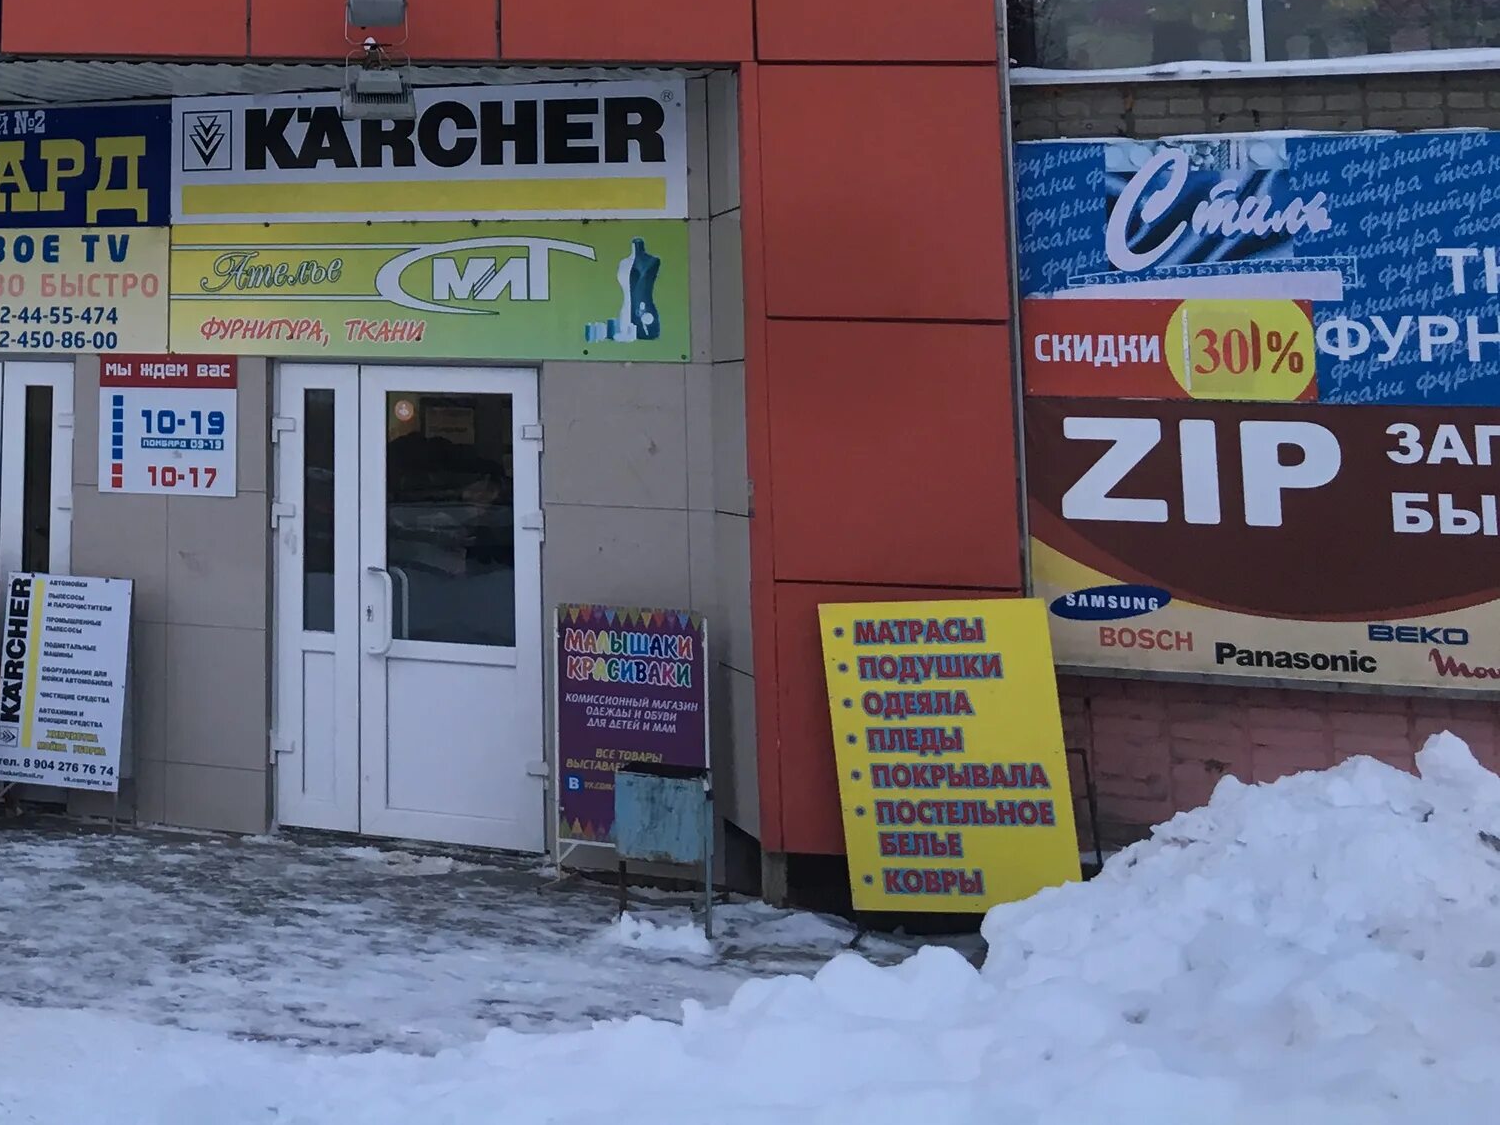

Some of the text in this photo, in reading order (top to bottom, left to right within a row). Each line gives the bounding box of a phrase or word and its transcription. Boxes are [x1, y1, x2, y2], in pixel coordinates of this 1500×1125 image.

[80, 234, 130, 263] TV
[40, 271, 159, 299] БЫСТРО
[200, 251, 343, 293] Ателье
[345, 318, 426, 342] ТКАНИ
[1034, 333, 1160, 366] СКИДКИ
[141, 410, 224, 435] 10-19
[148, 466, 217, 488] 10-17
[1062, 417, 1341, 527] ZIP
[1065, 593, 1159, 611] SAMSUNG
[564, 628, 694, 660] МАЛЫШАКИ
[853, 618, 986, 645] МАТРАСЫ
[1099, 627, 1194, 651] BOSCH
[1368, 624, 1469, 645] BEKO
[0, 578, 31, 723] KÄRCHER
[1215, 642, 1377, 673] Panasonic
[566, 655, 692, 688] КРАСИВАКИ
[858, 653, 1003, 683] ПОДУШКИ
[565, 692, 698, 712] КОМИССИОННЫЙ МАГАЗИН
[585, 706, 677, 722] ОДЕЖДЫ И ОБУВИ
[861, 690, 975, 720] ОДЕЯЛА
[587, 717, 676, 733] ДЛЯ ДЕТЕЙ И МАМ
[866, 726, 965, 756] ПЛЕДЫ
[24, 758, 31, 768] 8
[34, 759, 55, 770] 904
[58, 761, 79, 772] 276
[83, 764, 96, 774] 76
[100, 766, 114, 776] 74
[595, 748, 662, 763] ВСЕ ТОВАРЫ
[870, 763, 1050, 789] ПОКРЫВАЛА
[875, 799, 1056, 826] ПОСТЕЛЬНОЕ
[879, 831, 964, 857] БЕЛЬЕ
[883, 868, 985, 895] КОВРЫ
